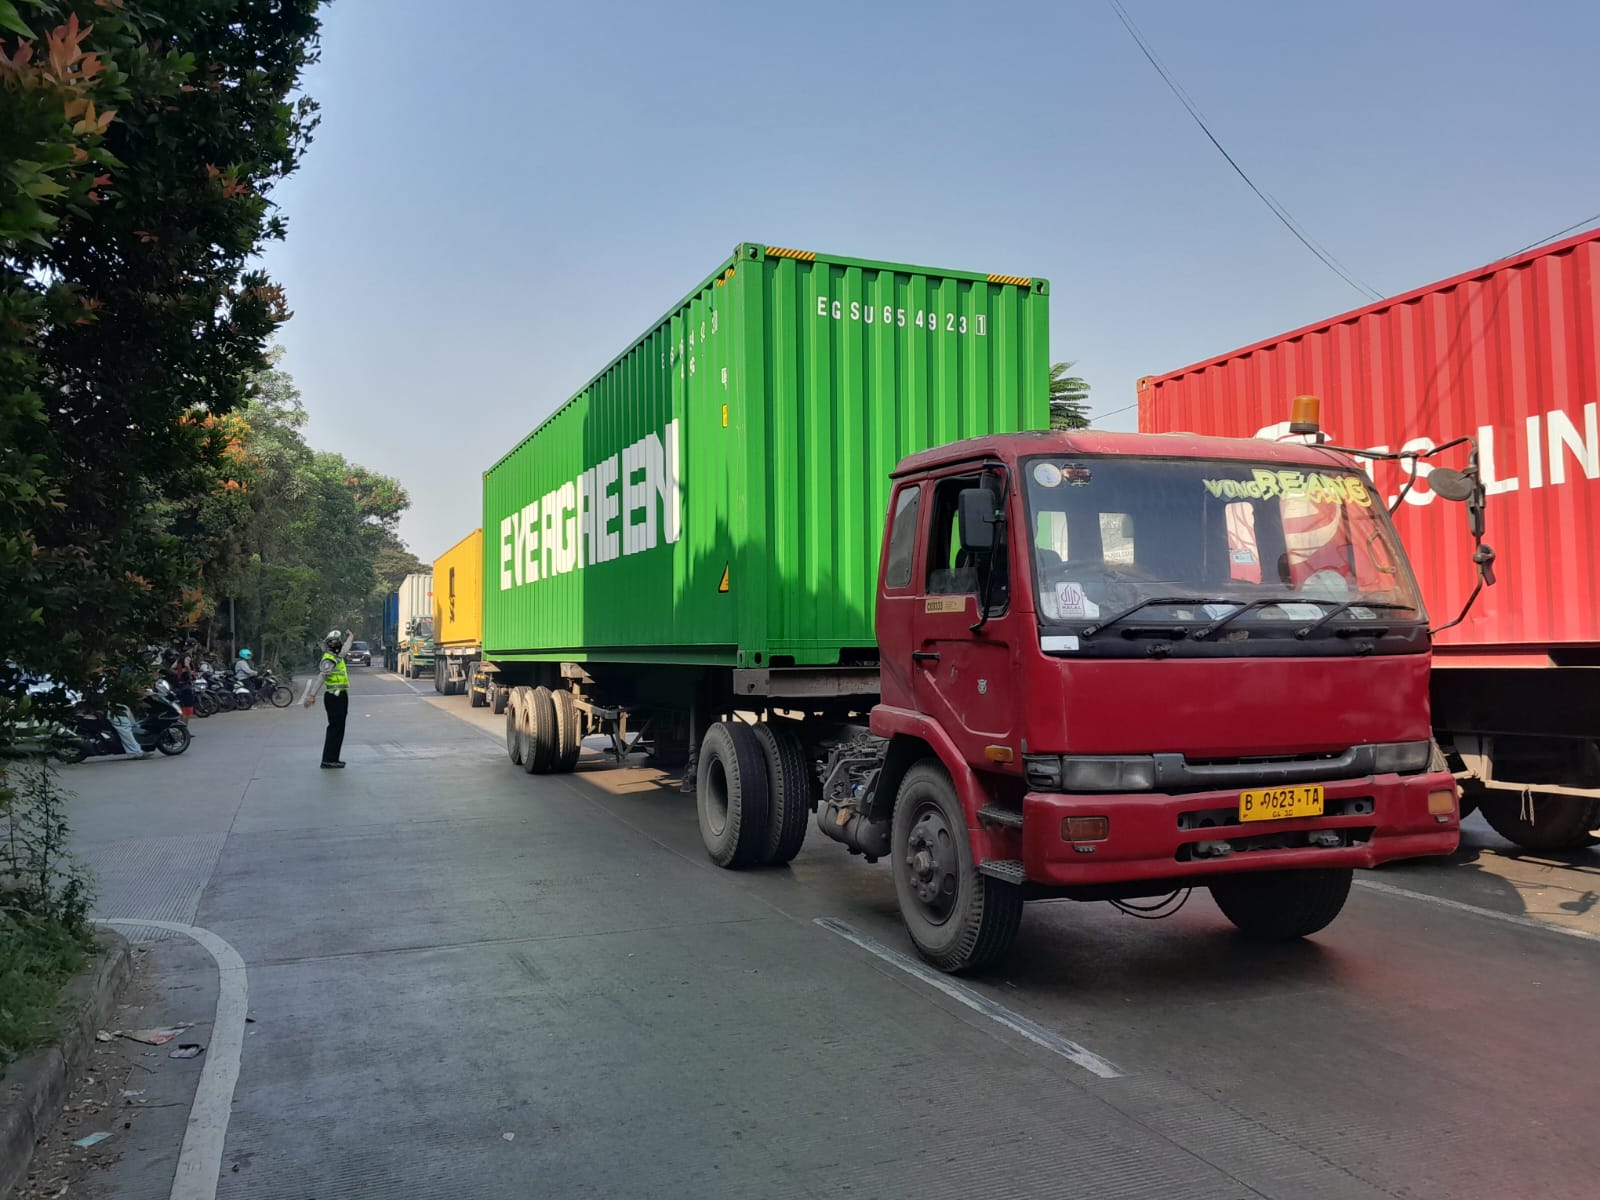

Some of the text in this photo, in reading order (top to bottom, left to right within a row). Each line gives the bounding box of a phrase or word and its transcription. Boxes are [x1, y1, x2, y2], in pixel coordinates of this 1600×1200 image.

[817, 296, 874, 324] EGSU
[883, 306, 967, 334] 654923
[1202, 478, 1257, 500] WONG
[500, 418, 680, 591] EVERGREEN
[1245, 788, 1319, 811] B 9623 TA
